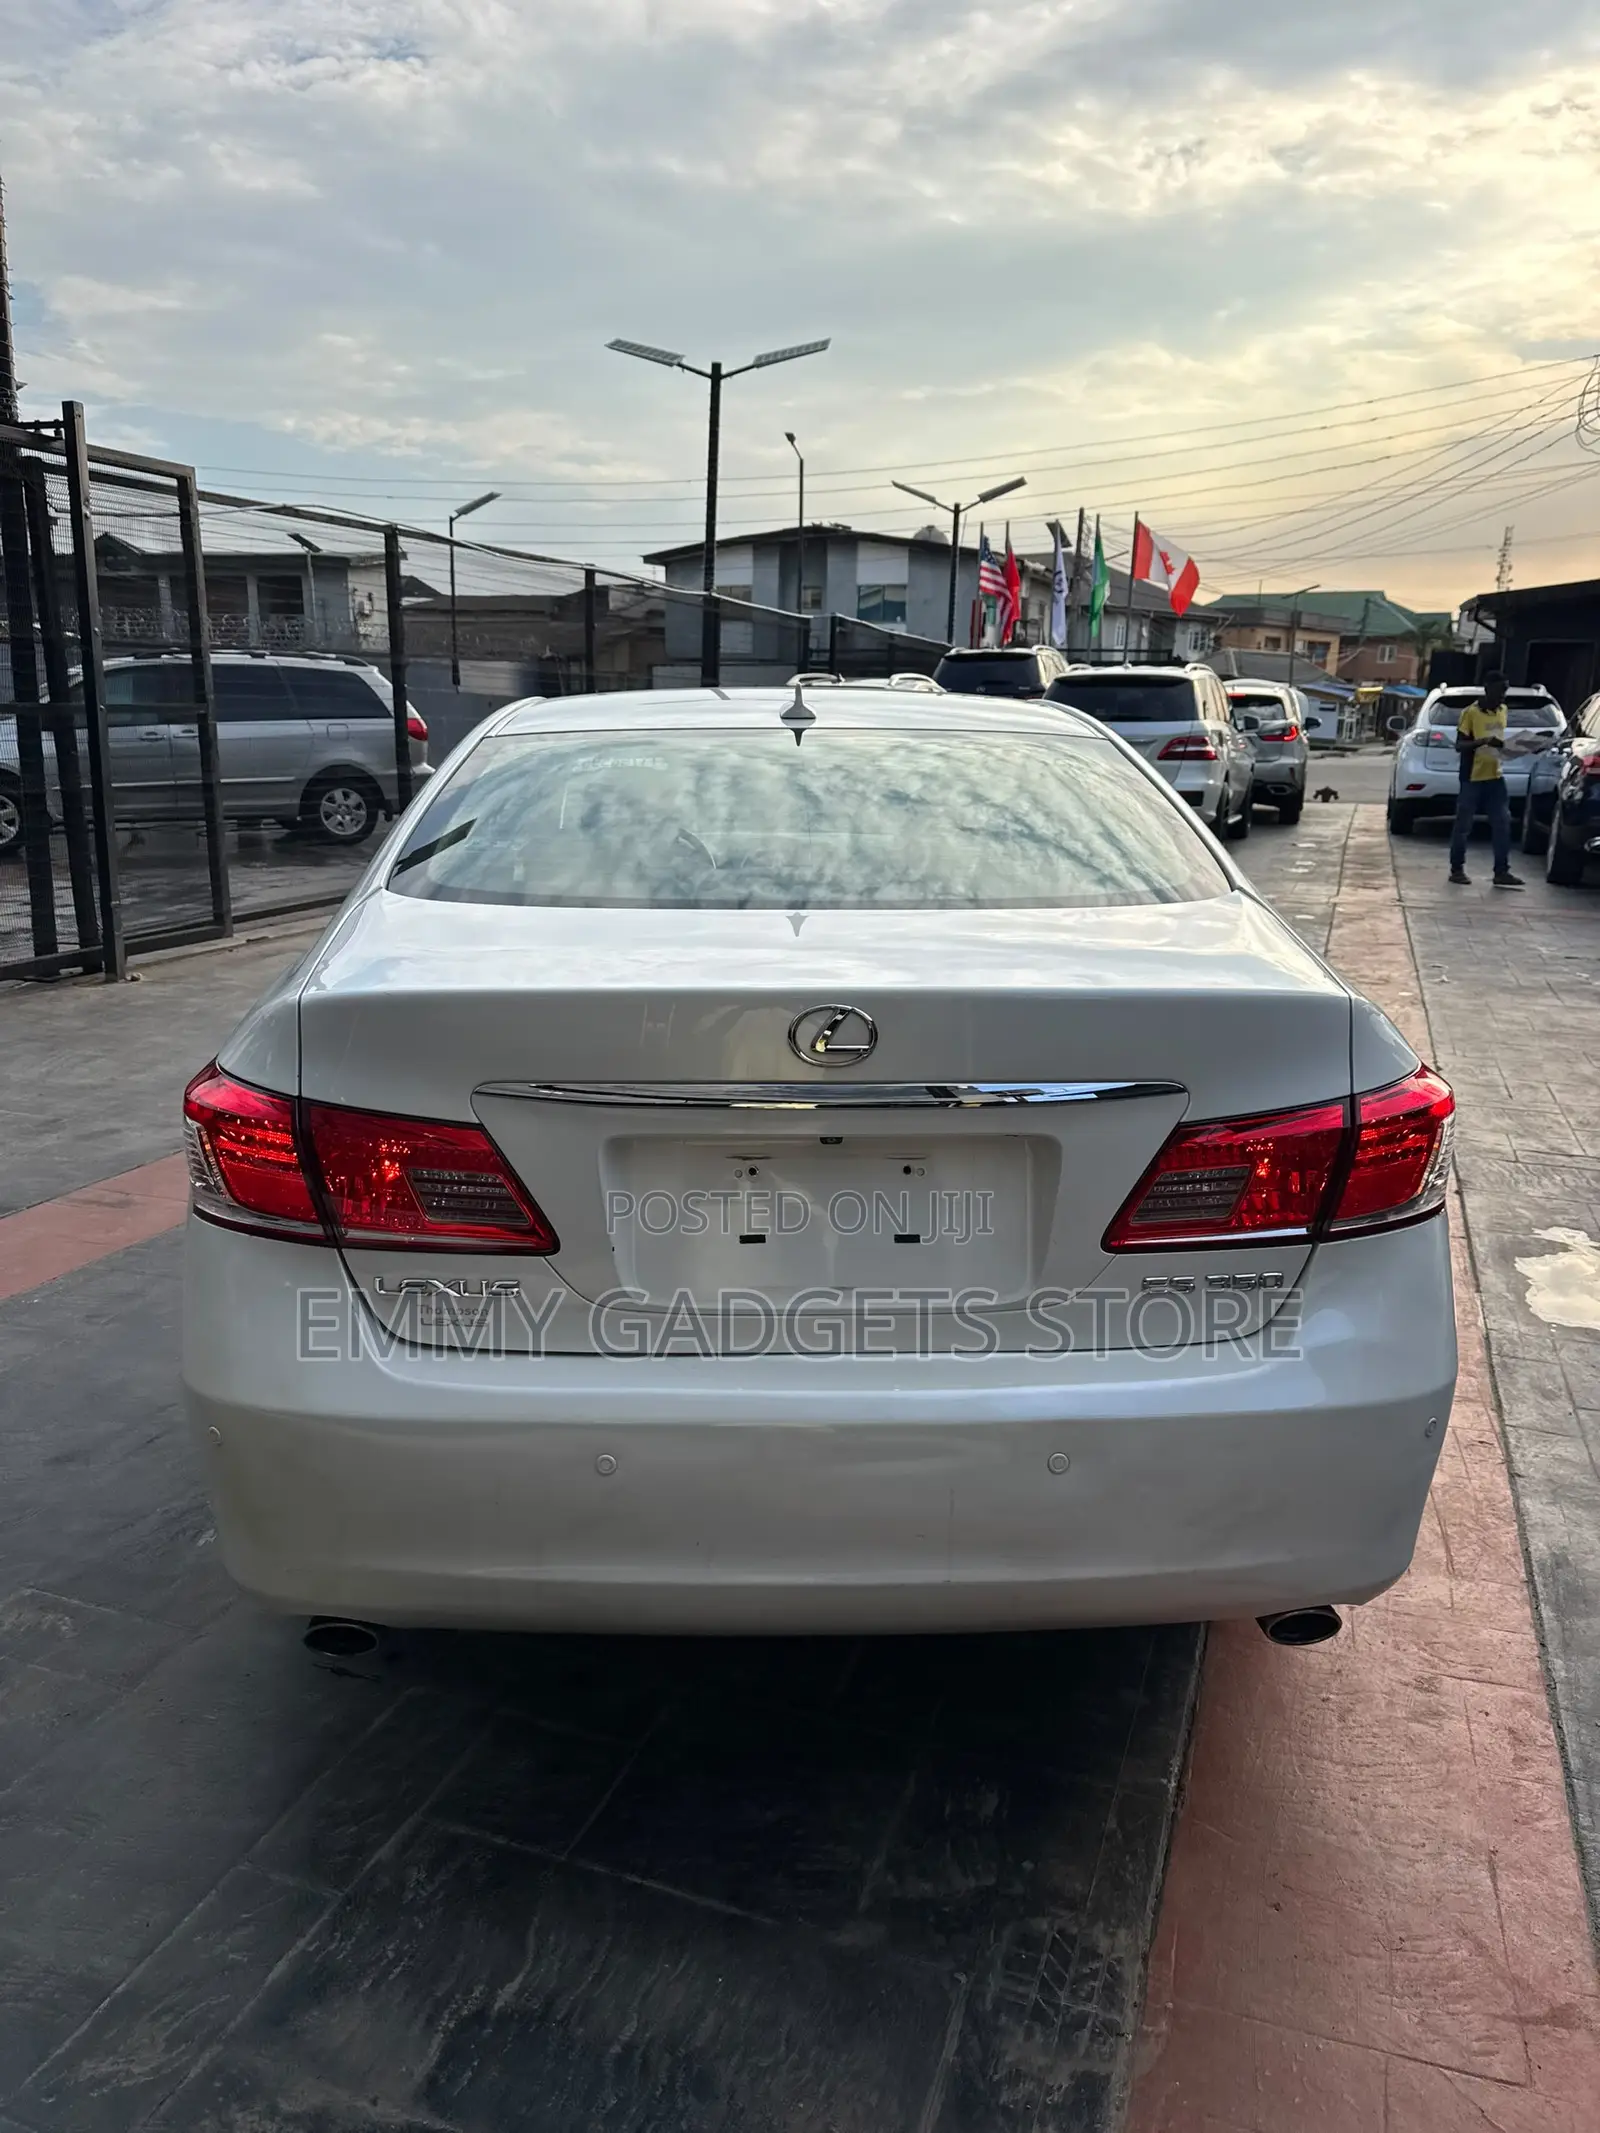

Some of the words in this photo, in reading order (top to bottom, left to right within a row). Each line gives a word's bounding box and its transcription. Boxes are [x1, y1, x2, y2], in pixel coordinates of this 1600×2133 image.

[374, 1277, 520, 1297] LEXUS
[1142, 1276, 1195, 1294] ES
[1205, 1271, 1284, 1292] 350
